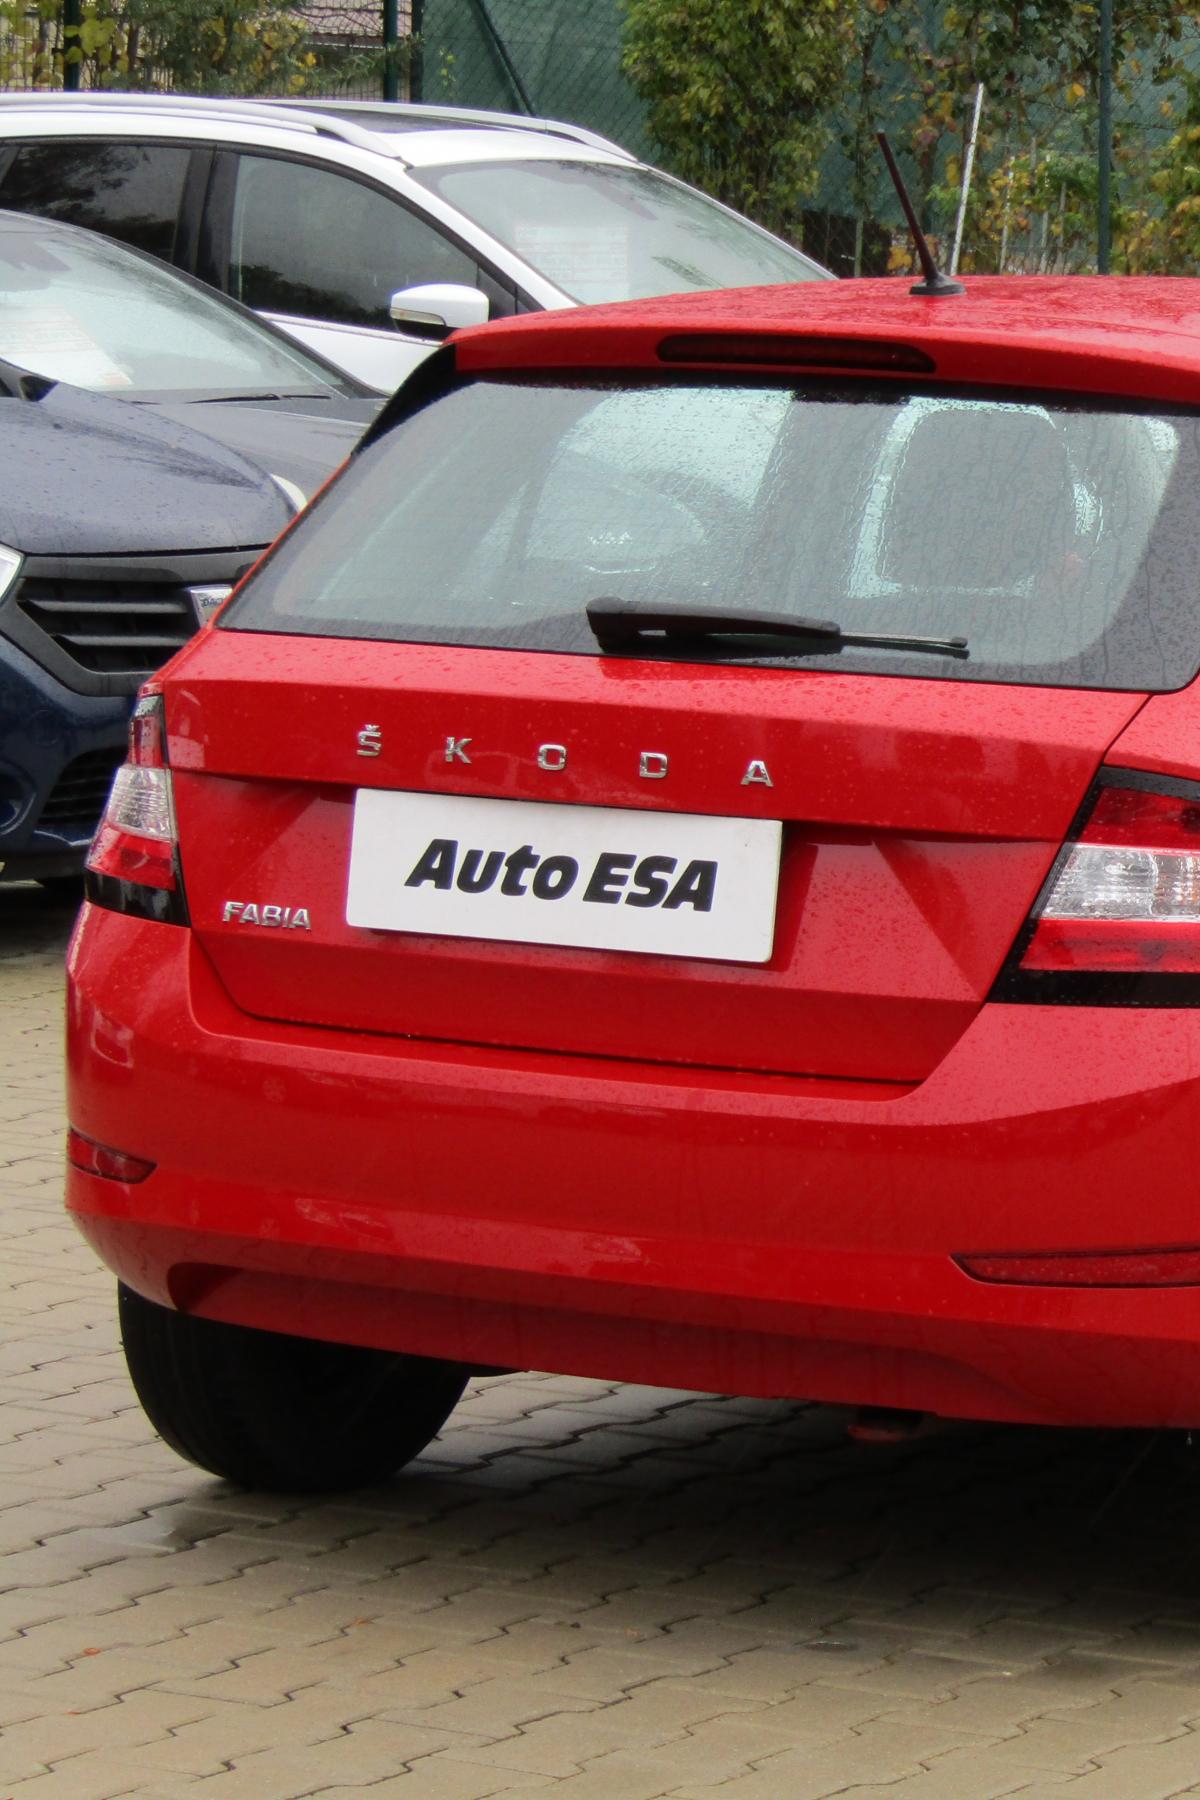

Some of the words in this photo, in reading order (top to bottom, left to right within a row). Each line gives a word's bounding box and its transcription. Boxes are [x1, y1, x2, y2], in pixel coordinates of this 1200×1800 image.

[356, 724, 774, 788] ŠKODA
[404, 838, 579, 900] Auto
[582, 852, 718, 912] ESA
[222, 901, 311, 930] FABIA
